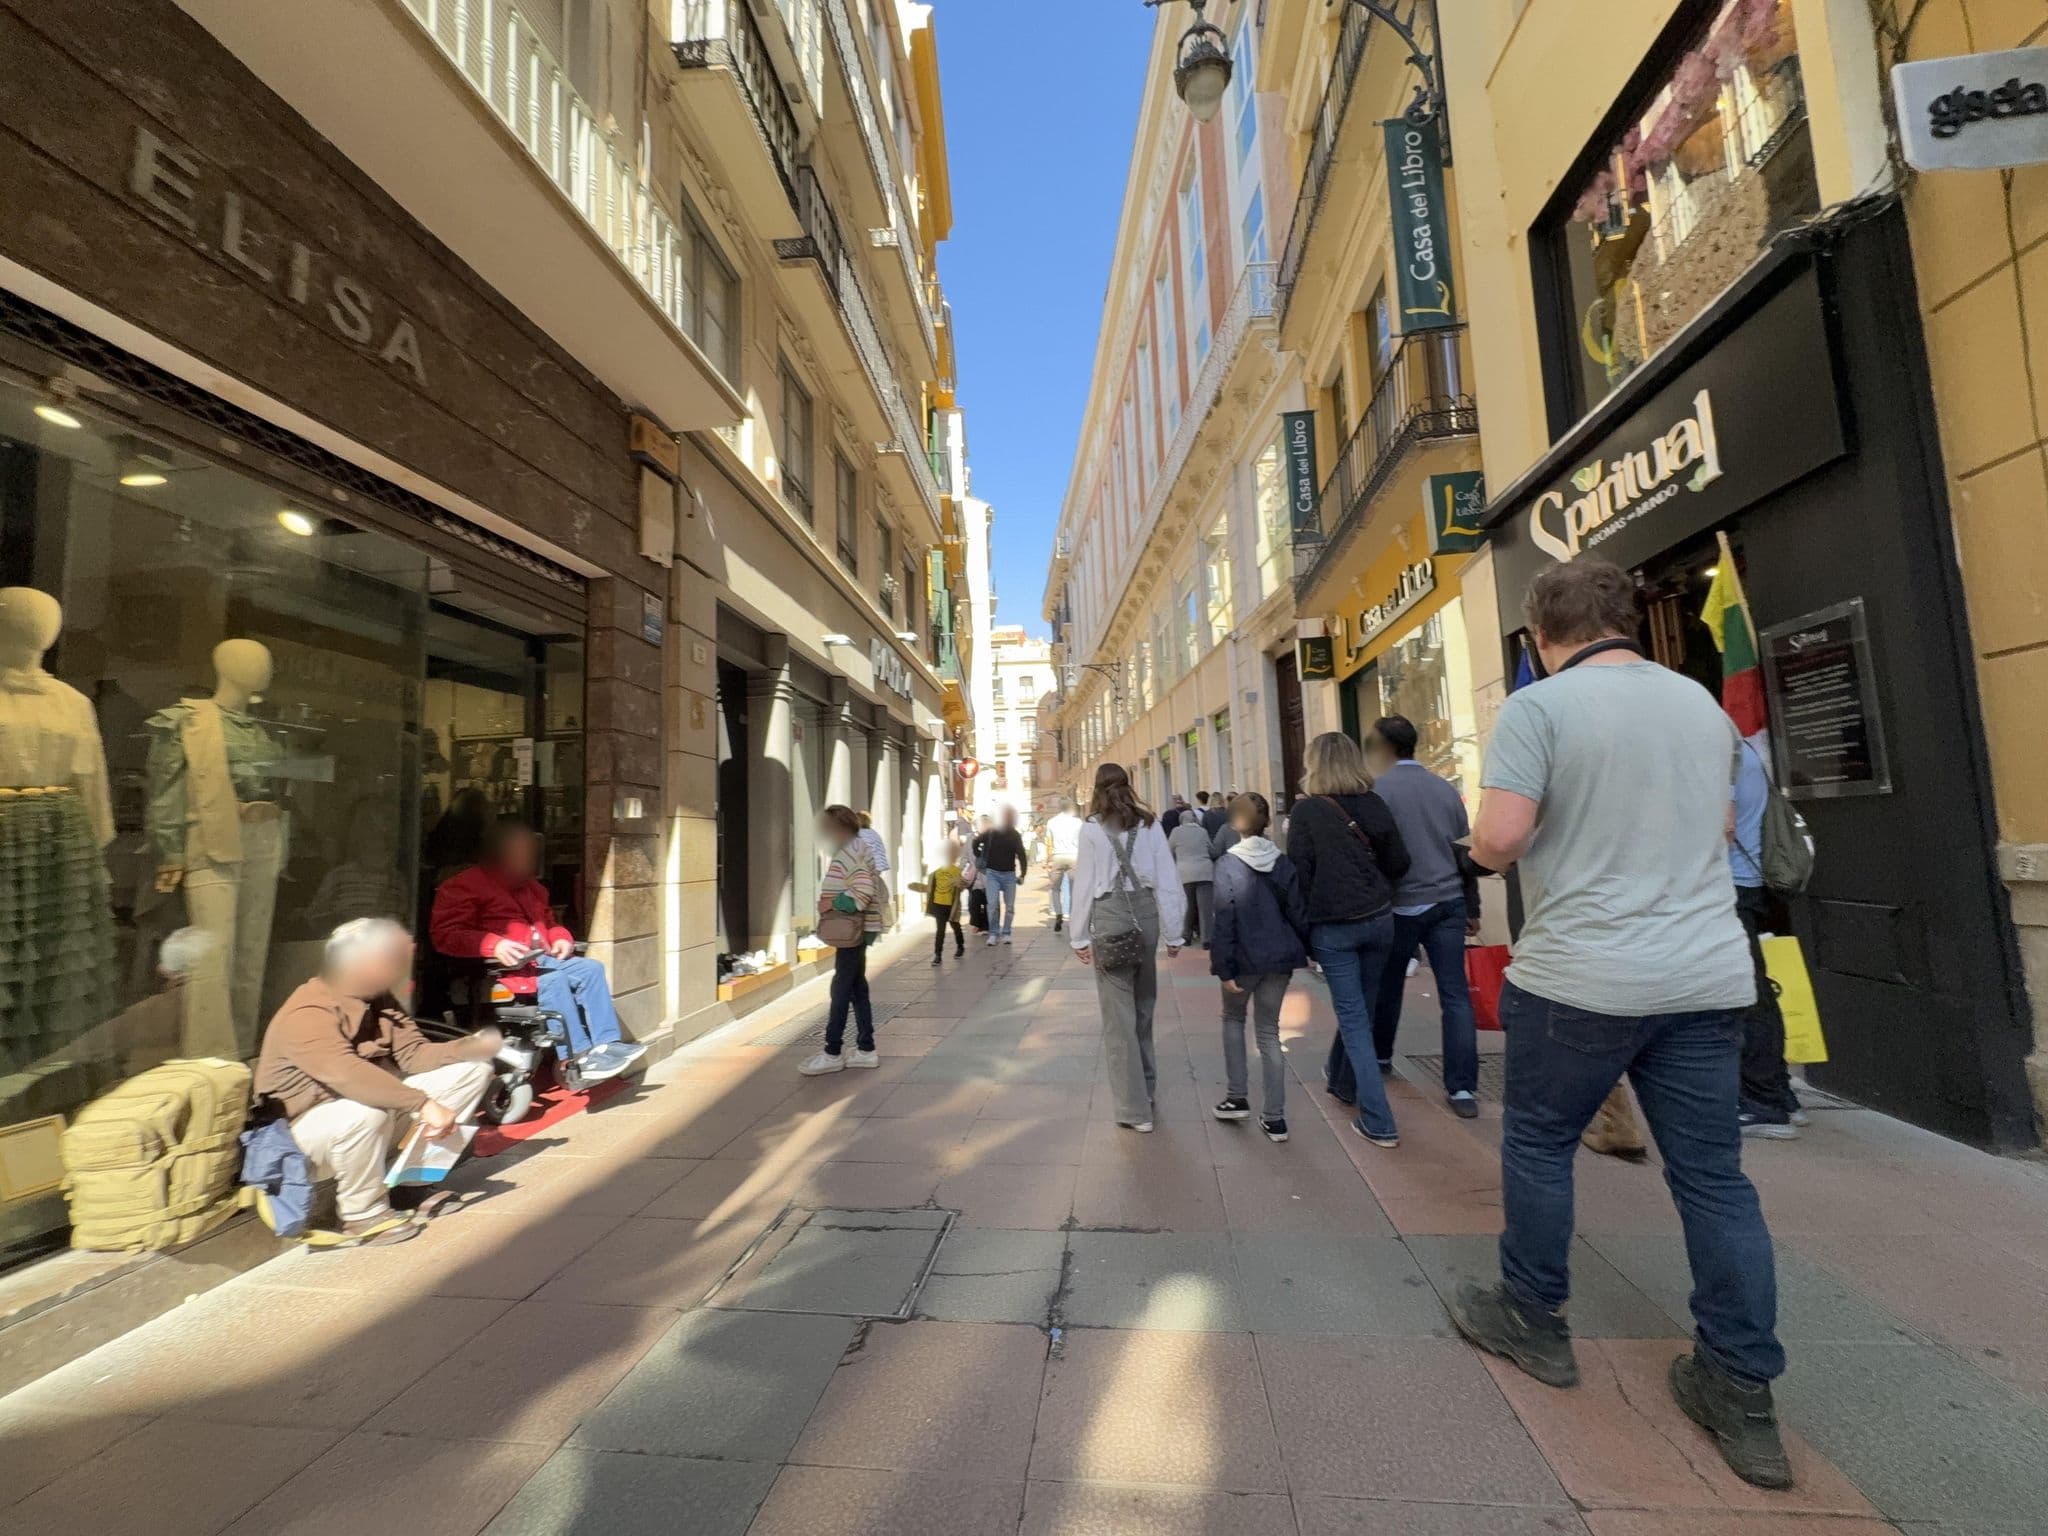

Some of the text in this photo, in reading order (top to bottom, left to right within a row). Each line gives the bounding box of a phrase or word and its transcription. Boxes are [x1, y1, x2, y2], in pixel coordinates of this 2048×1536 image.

[130, 126, 427, 387] ELISA
[1400, 130, 1435, 281] Casa del Libro
[1291, 419, 1313, 512] Casa del Libro
[1530, 389, 1723, 563] Spiritual
